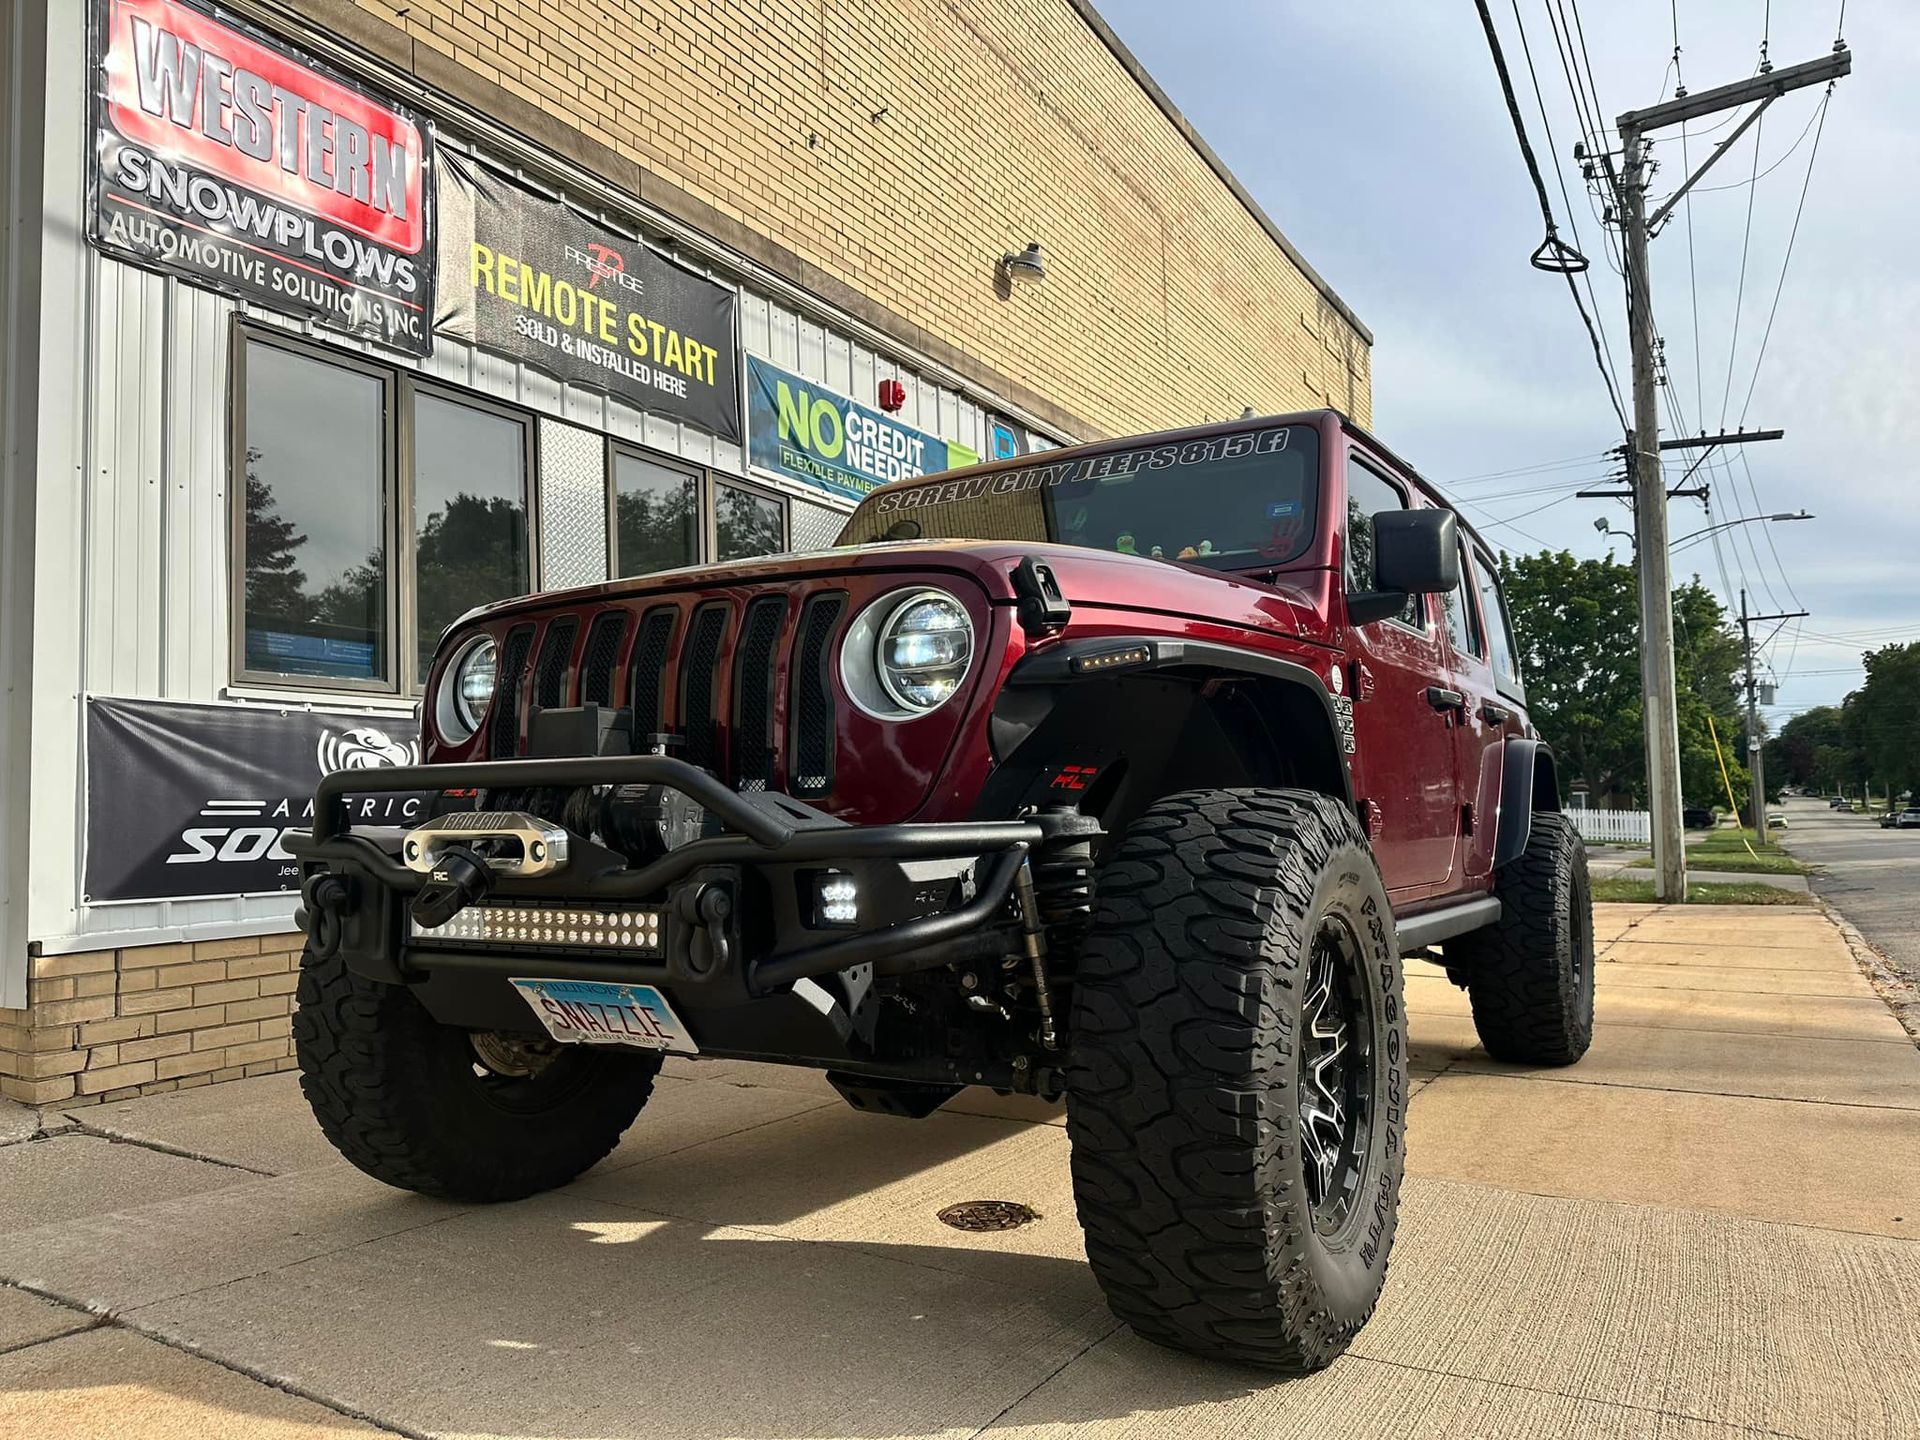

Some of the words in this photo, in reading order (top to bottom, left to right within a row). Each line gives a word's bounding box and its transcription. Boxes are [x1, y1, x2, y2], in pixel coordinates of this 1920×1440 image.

[131, 15, 407, 221] WESTERN
[118, 147, 417, 293] SNOWPLOWS
[109, 211, 266, 286] AUTOMOTIVE
[272, 267, 384, 325] SOLUTIONS
[387, 306, 424, 341] INC.
[564, 245, 644, 295] PRESTIGE
[470, 241, 618, 346] REMOTE
[627, 313, 718, 386] START
[515, 314, 558, 348] SOLD
[561, 333, 574, 355] &
[577, 337, 650, 385] INSTALLED
[653, 368, 688, 399] HERE
[777, 380, 844, 458] NO
[845, 411, 925, 466] CREDIT
[783, 451, 834, 481] FLEXIBLE
[878, 475, 993, 514] SCREW
[991, 463, 1075, 495] CITY
[1071, 446, 1178, 482] JEEPS
[1180, 434, 1254, 464] 815
[433, 871, 449, 882] RC
[540, 998, 674, 1040] SNAZZIE
[1361, 895, 1400, 1159] PATAGONIA
